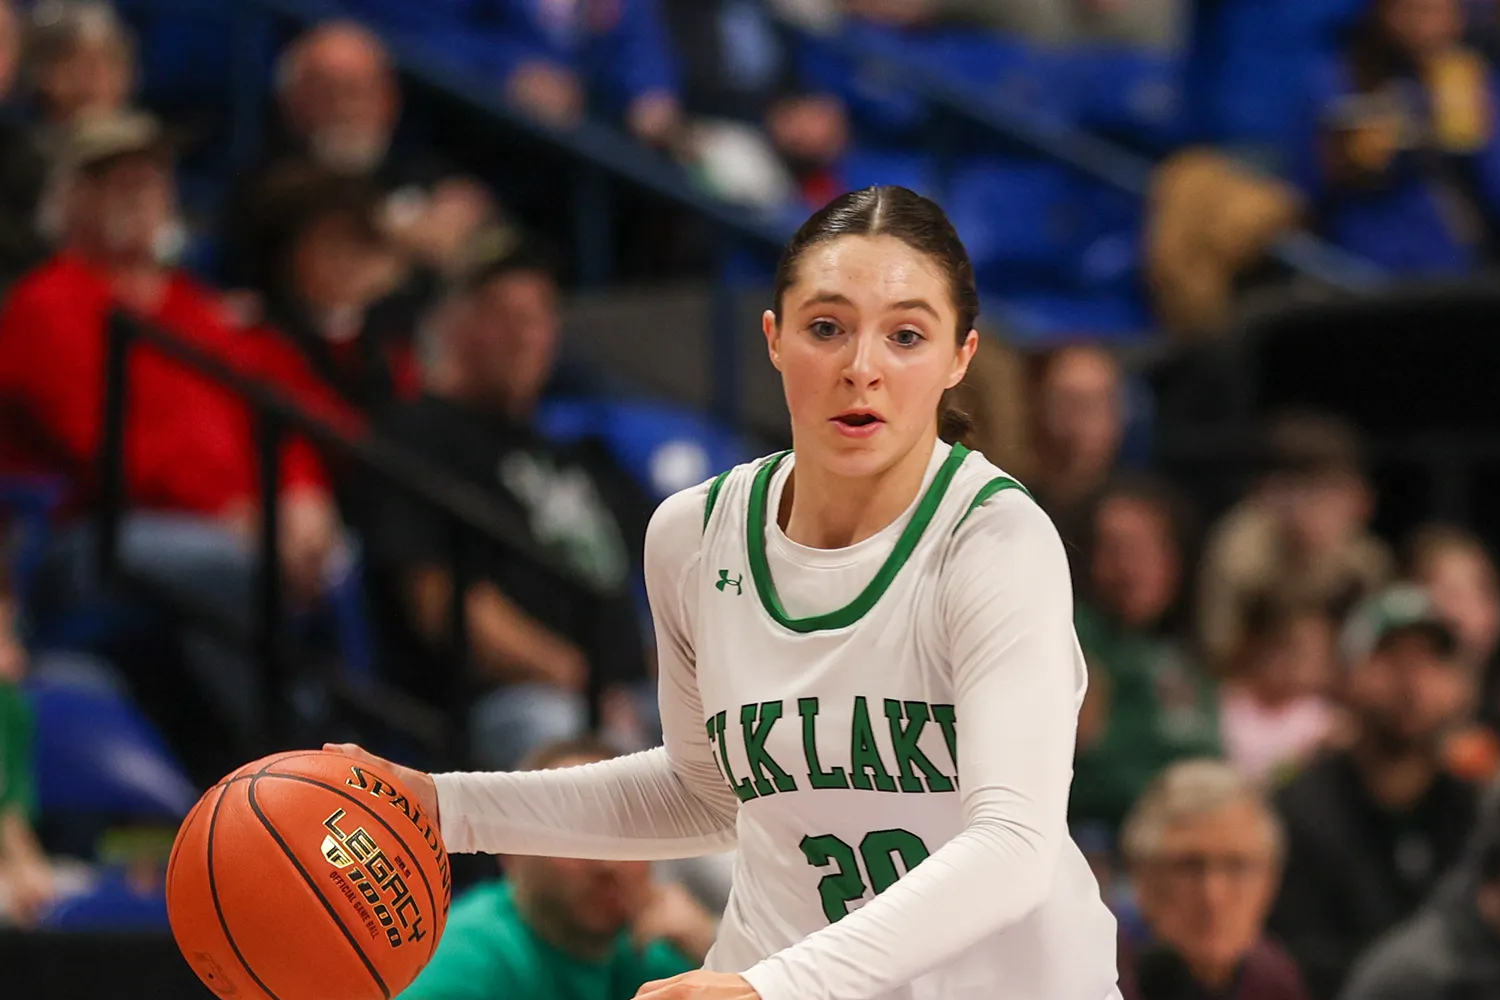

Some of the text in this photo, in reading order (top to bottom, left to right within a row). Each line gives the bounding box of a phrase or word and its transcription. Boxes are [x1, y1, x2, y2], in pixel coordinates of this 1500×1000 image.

[322, 808, 427, 943] LEGACY
[329, 871, 381, 940] OFFICIAL GAME BALL
[347, 867, 403, 949] 1000
